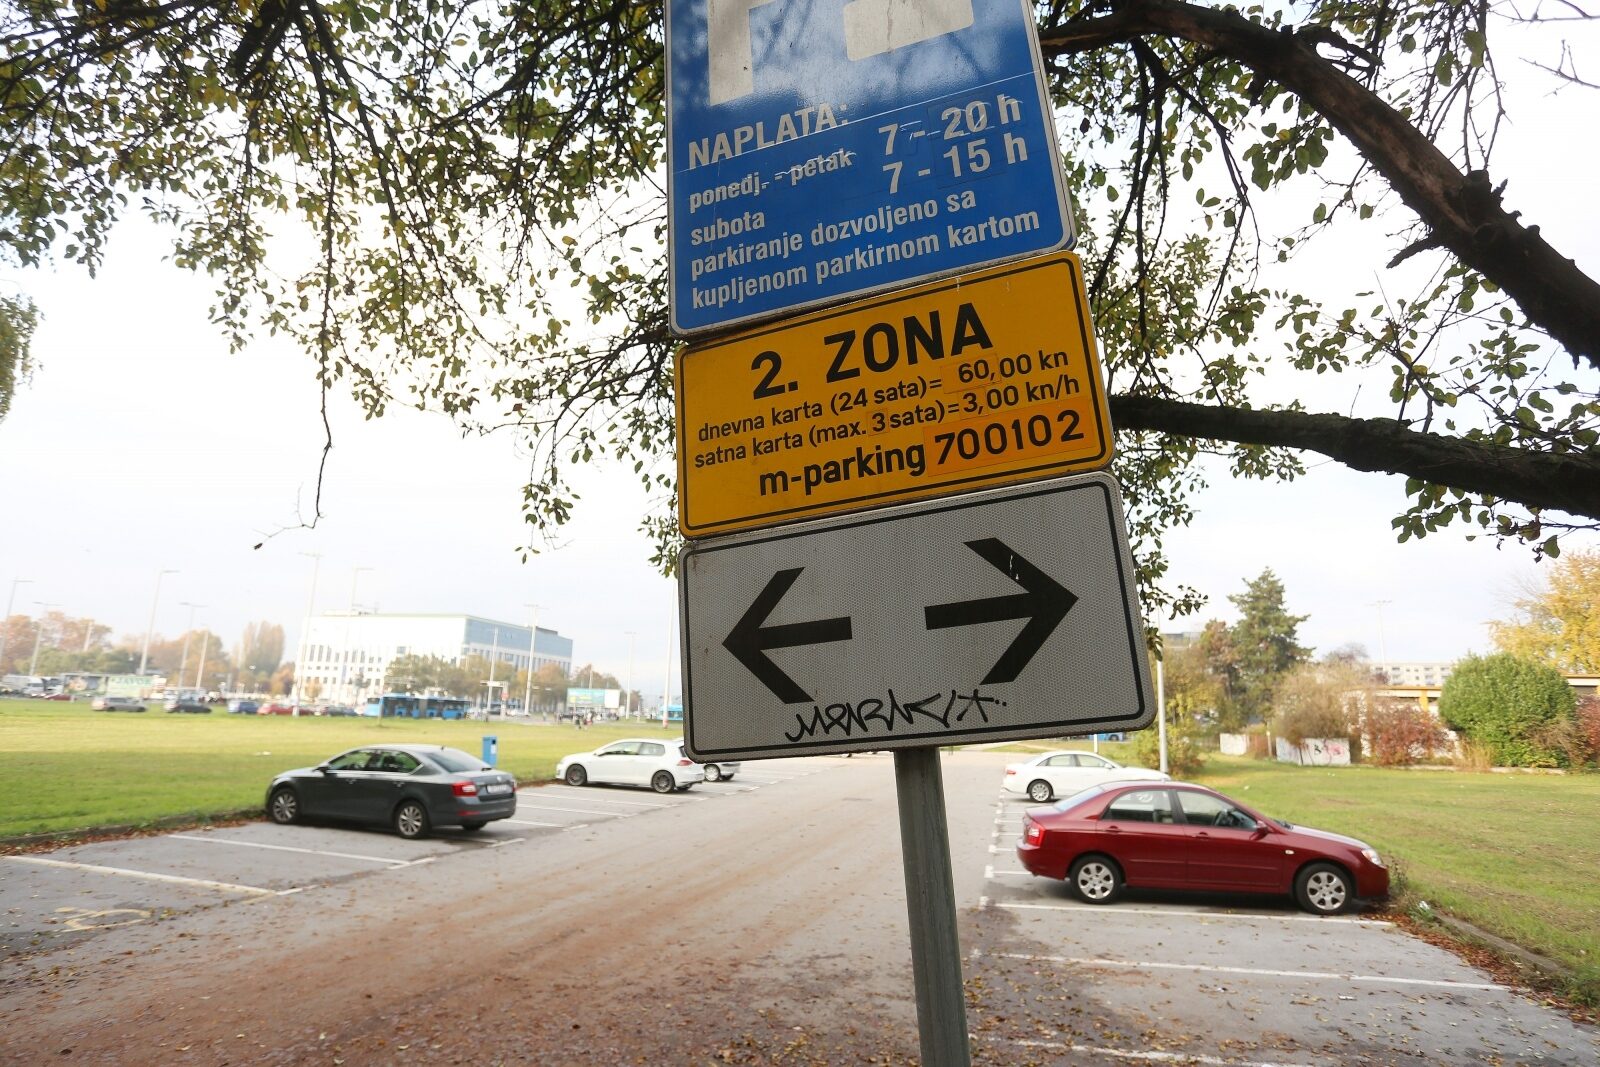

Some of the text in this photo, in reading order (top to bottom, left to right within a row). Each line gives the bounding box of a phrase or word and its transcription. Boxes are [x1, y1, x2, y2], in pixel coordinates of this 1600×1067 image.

[688, 102, 848, 170] NAPLATA:
[689, 171, 768, 214] ponedj.
[790, 147, 854, 186] petak
[878, 123, 898, 156] 7
[941, 100, 988, 140] 20
[996, 93, 1022, 125] h
[690, 211, 765, 246] subota
[882, 160, 903, 195] 7
[943, 138, 991, 178] 15
[1003, 132, 1028, 165] h
[691, 189, 977, 281] parkiranje dozvoljeno sa
[692, 211, 1040, 309] kupljenom parkirnom kartom
[698, 349, 1069, 442] dnevna karta (24 sata)= 60,00 kn
[750, 302, 993, 400] 2. ZONA
[694, 445, 747, 469] satna
[752, 432, 803, 457] karta
[808, 419, 867, 448] (max.
[1025, 374, 1080, 403] kn/h
[759, 409, 1085, 497] m-parking 700102
